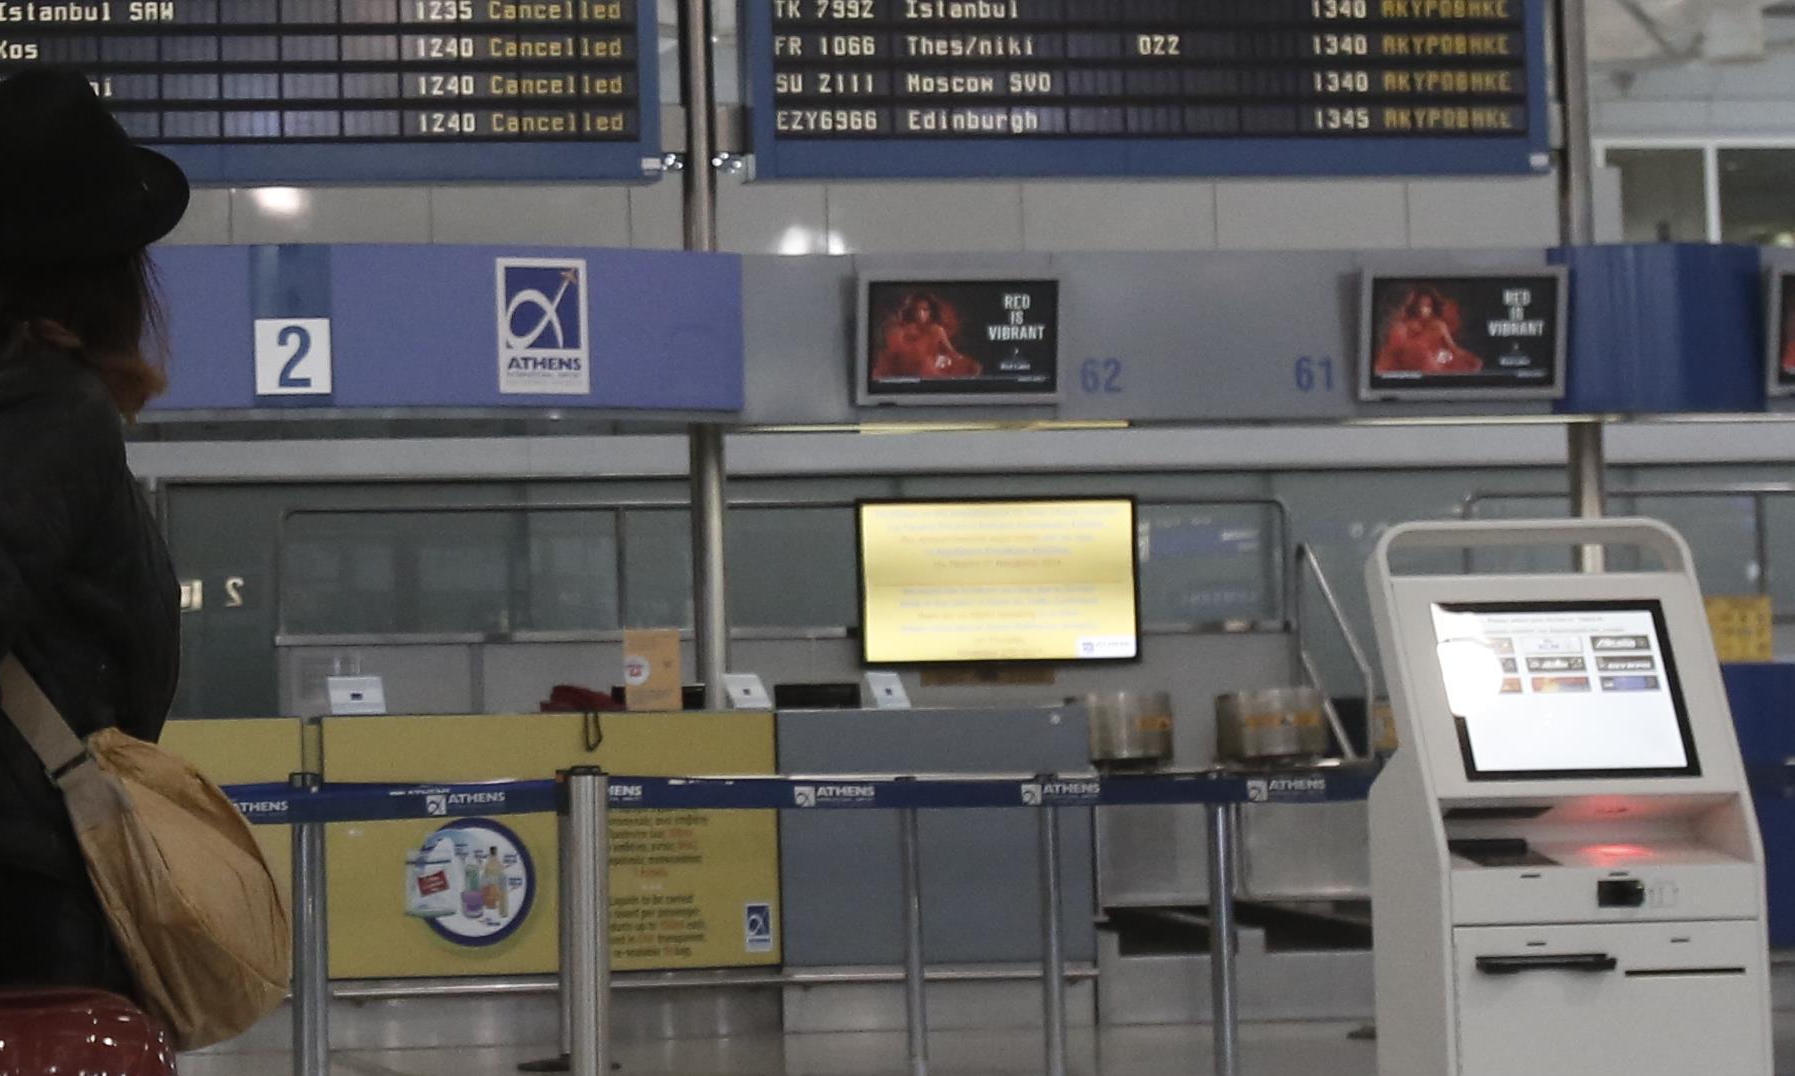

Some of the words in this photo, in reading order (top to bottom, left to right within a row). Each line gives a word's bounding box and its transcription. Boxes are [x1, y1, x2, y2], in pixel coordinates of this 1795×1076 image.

[130, 1, 174, 20] SAW
[416, 0, 473, 21] 1235
[488, 0, 622, 20] Cancelled
[773, 0, 802, 19] TK
[816, 0, 875, 19] 7992
[906, 0, 1019, 19] Istanbul
[1312, 0, 1368, 19] 1340
[417, 37, 474, 58] 1240
[489, 37, 623, 57] Cancelled
[774, 35, 802, 56] FR
[819, 35, 875, 56] 1066
[907, 35, 1035, 56] Thes/niki
[1139, 34, 1181, 56] 022
[1312, 34, 1369, 56] 1340
[417, 76, 475, 96] 1240
[490, 75, 624, 95] Cancelled
[775, 72, 803, 94] SU
[818, 72, 875, 94] 2111
[907, 71, 994, 93] Moscow
[1009, 71, 1052, 93] SVO
[1313, 71, 1369, 93] 1340
[418, 113, 476, 134] 1240
[491, 112, 625, 132] Cancelled
[776, 109, 878, 131] EZY6966
[908, 109, 1038, 134] Edinburgh
[1314, 108, 1371, 130] 1345
[1004, 293, 1031, 310] RED
[1503, 288, 1532, 307] RED
[1010, 310, 1024, 325] IS
[988, 325, 1045, 342] VIBRANT
[1487, 319, 1545, 338] VIBRANT
[277, 325, 312, 389] 2
[507, 356, 583, 371] ATHENS
[1081, 357, 1122, 393] 62
[1295, 356, 1334, 393] 61
[816, 785, 876, 798] ATHENS
[1043, 782, 1102, 796] ATHENS
[1268, 779, 1326, 792] ATHENS
[234, 800, 289, 814] THENS
[448, 791, 506, 805] ATHENS
